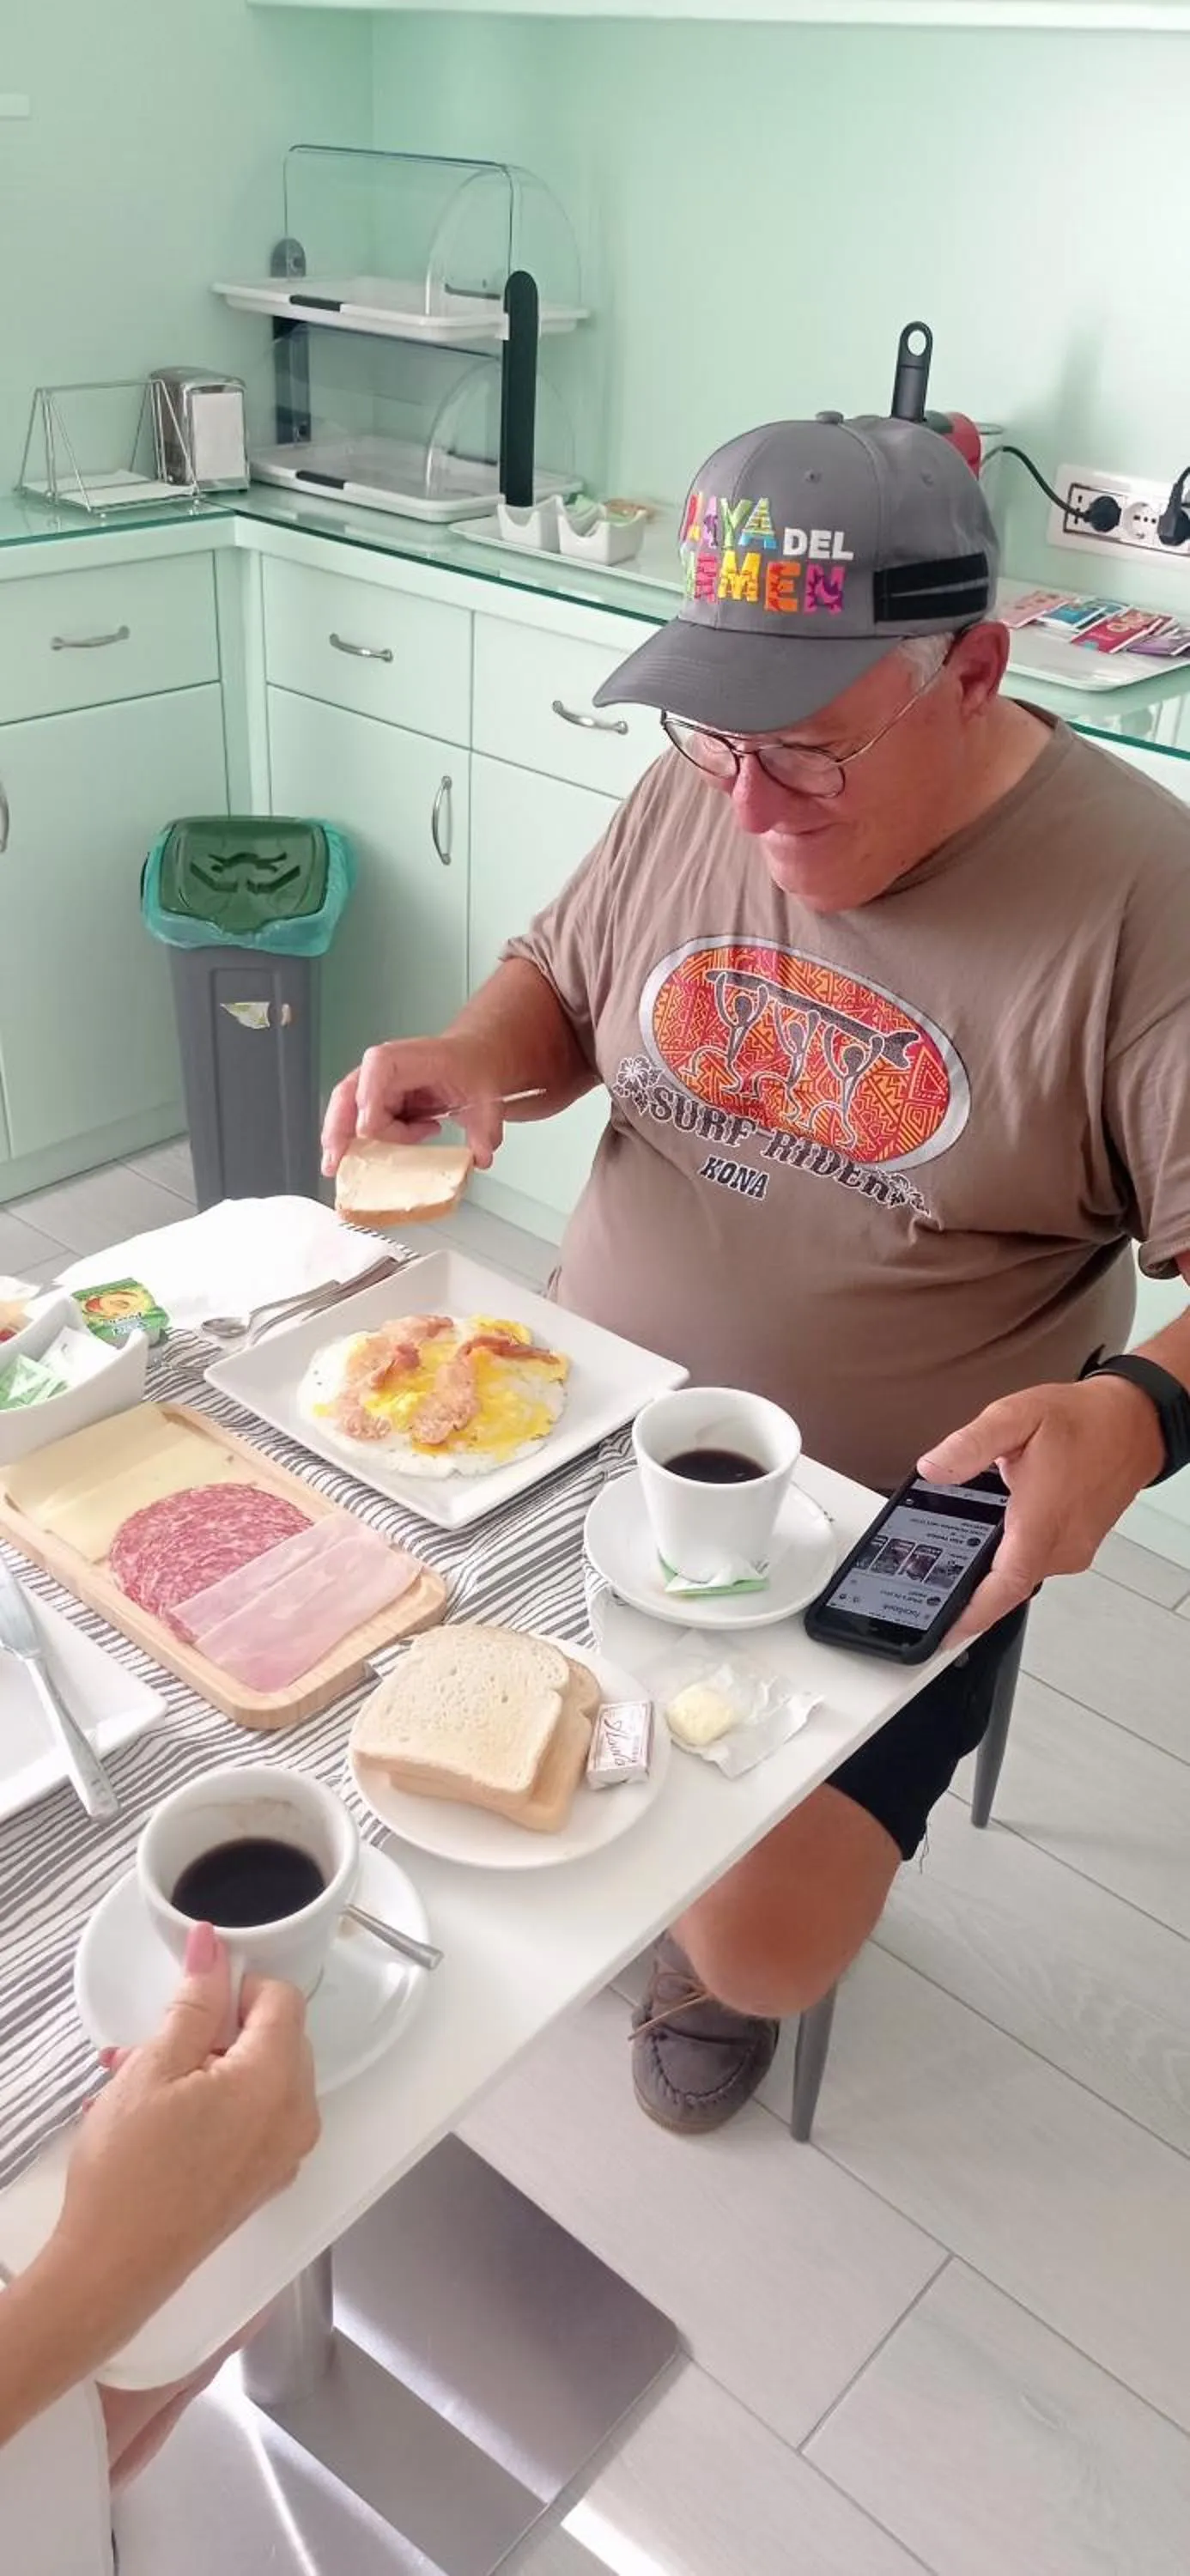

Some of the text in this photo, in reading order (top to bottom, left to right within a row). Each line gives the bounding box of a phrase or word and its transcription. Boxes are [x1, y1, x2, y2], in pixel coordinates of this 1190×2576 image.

[782, 526, 854, 562] DEL
[649, 1085, 895, 1206] SURF RIDER
[696, 1154, 770, 1200] KONA
